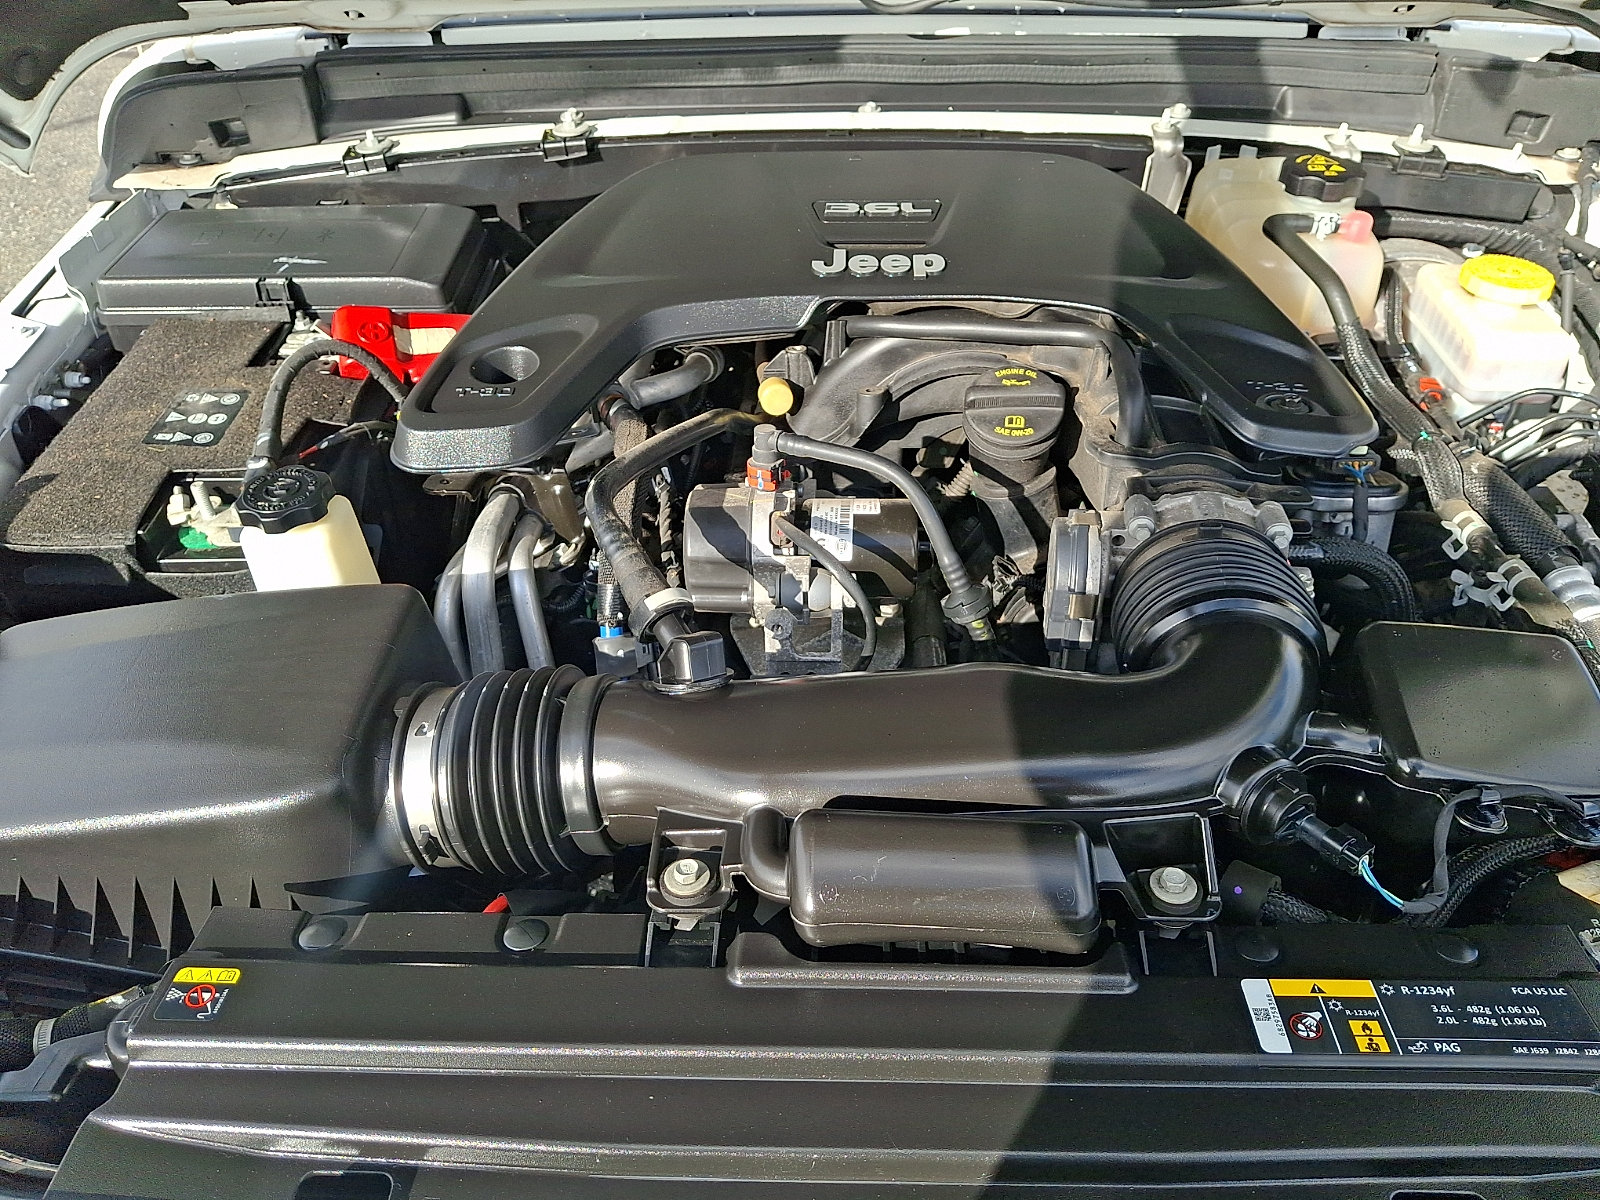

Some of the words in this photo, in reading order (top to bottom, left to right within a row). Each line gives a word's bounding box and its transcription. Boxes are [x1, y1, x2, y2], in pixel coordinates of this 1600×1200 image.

[824, 202, 933, 217] 3.6L
[811, 248, 946, 280] Jeep
[995, 368, 1025, 378] ENGINE
[1025, 369, 1038, 379] OIL
[994, 426, 1011, 436] SAE
[1400, 985, 1456, 997] R-1234yf
[1511, 987, 1533, 996] FCA
[1532, 987, 1548, 996] US
[1548, 987, 1568, 996] LLC
[1345, 1009, 1380, 1018] R-1234yf
[1430, 1004, 1454, 1013] 3.6L
[1466, 1005, 1493, 1015] 482g
[1494, 1005, 1521, 1015] (1.06
[1522, 1005, 1540, 1016] Lb)
[1436, 1016, 1460, 1025] 2.0L
[1472, 1016, 1499, 1027] 482g
[1500, 1016, 1528, 1027] (1.06
[1529, 1017, 1547, 1028] Lb)
[1433, 1042, 1462, 1053] PAG
[1512, 1046, 1530, 1054] SAE
